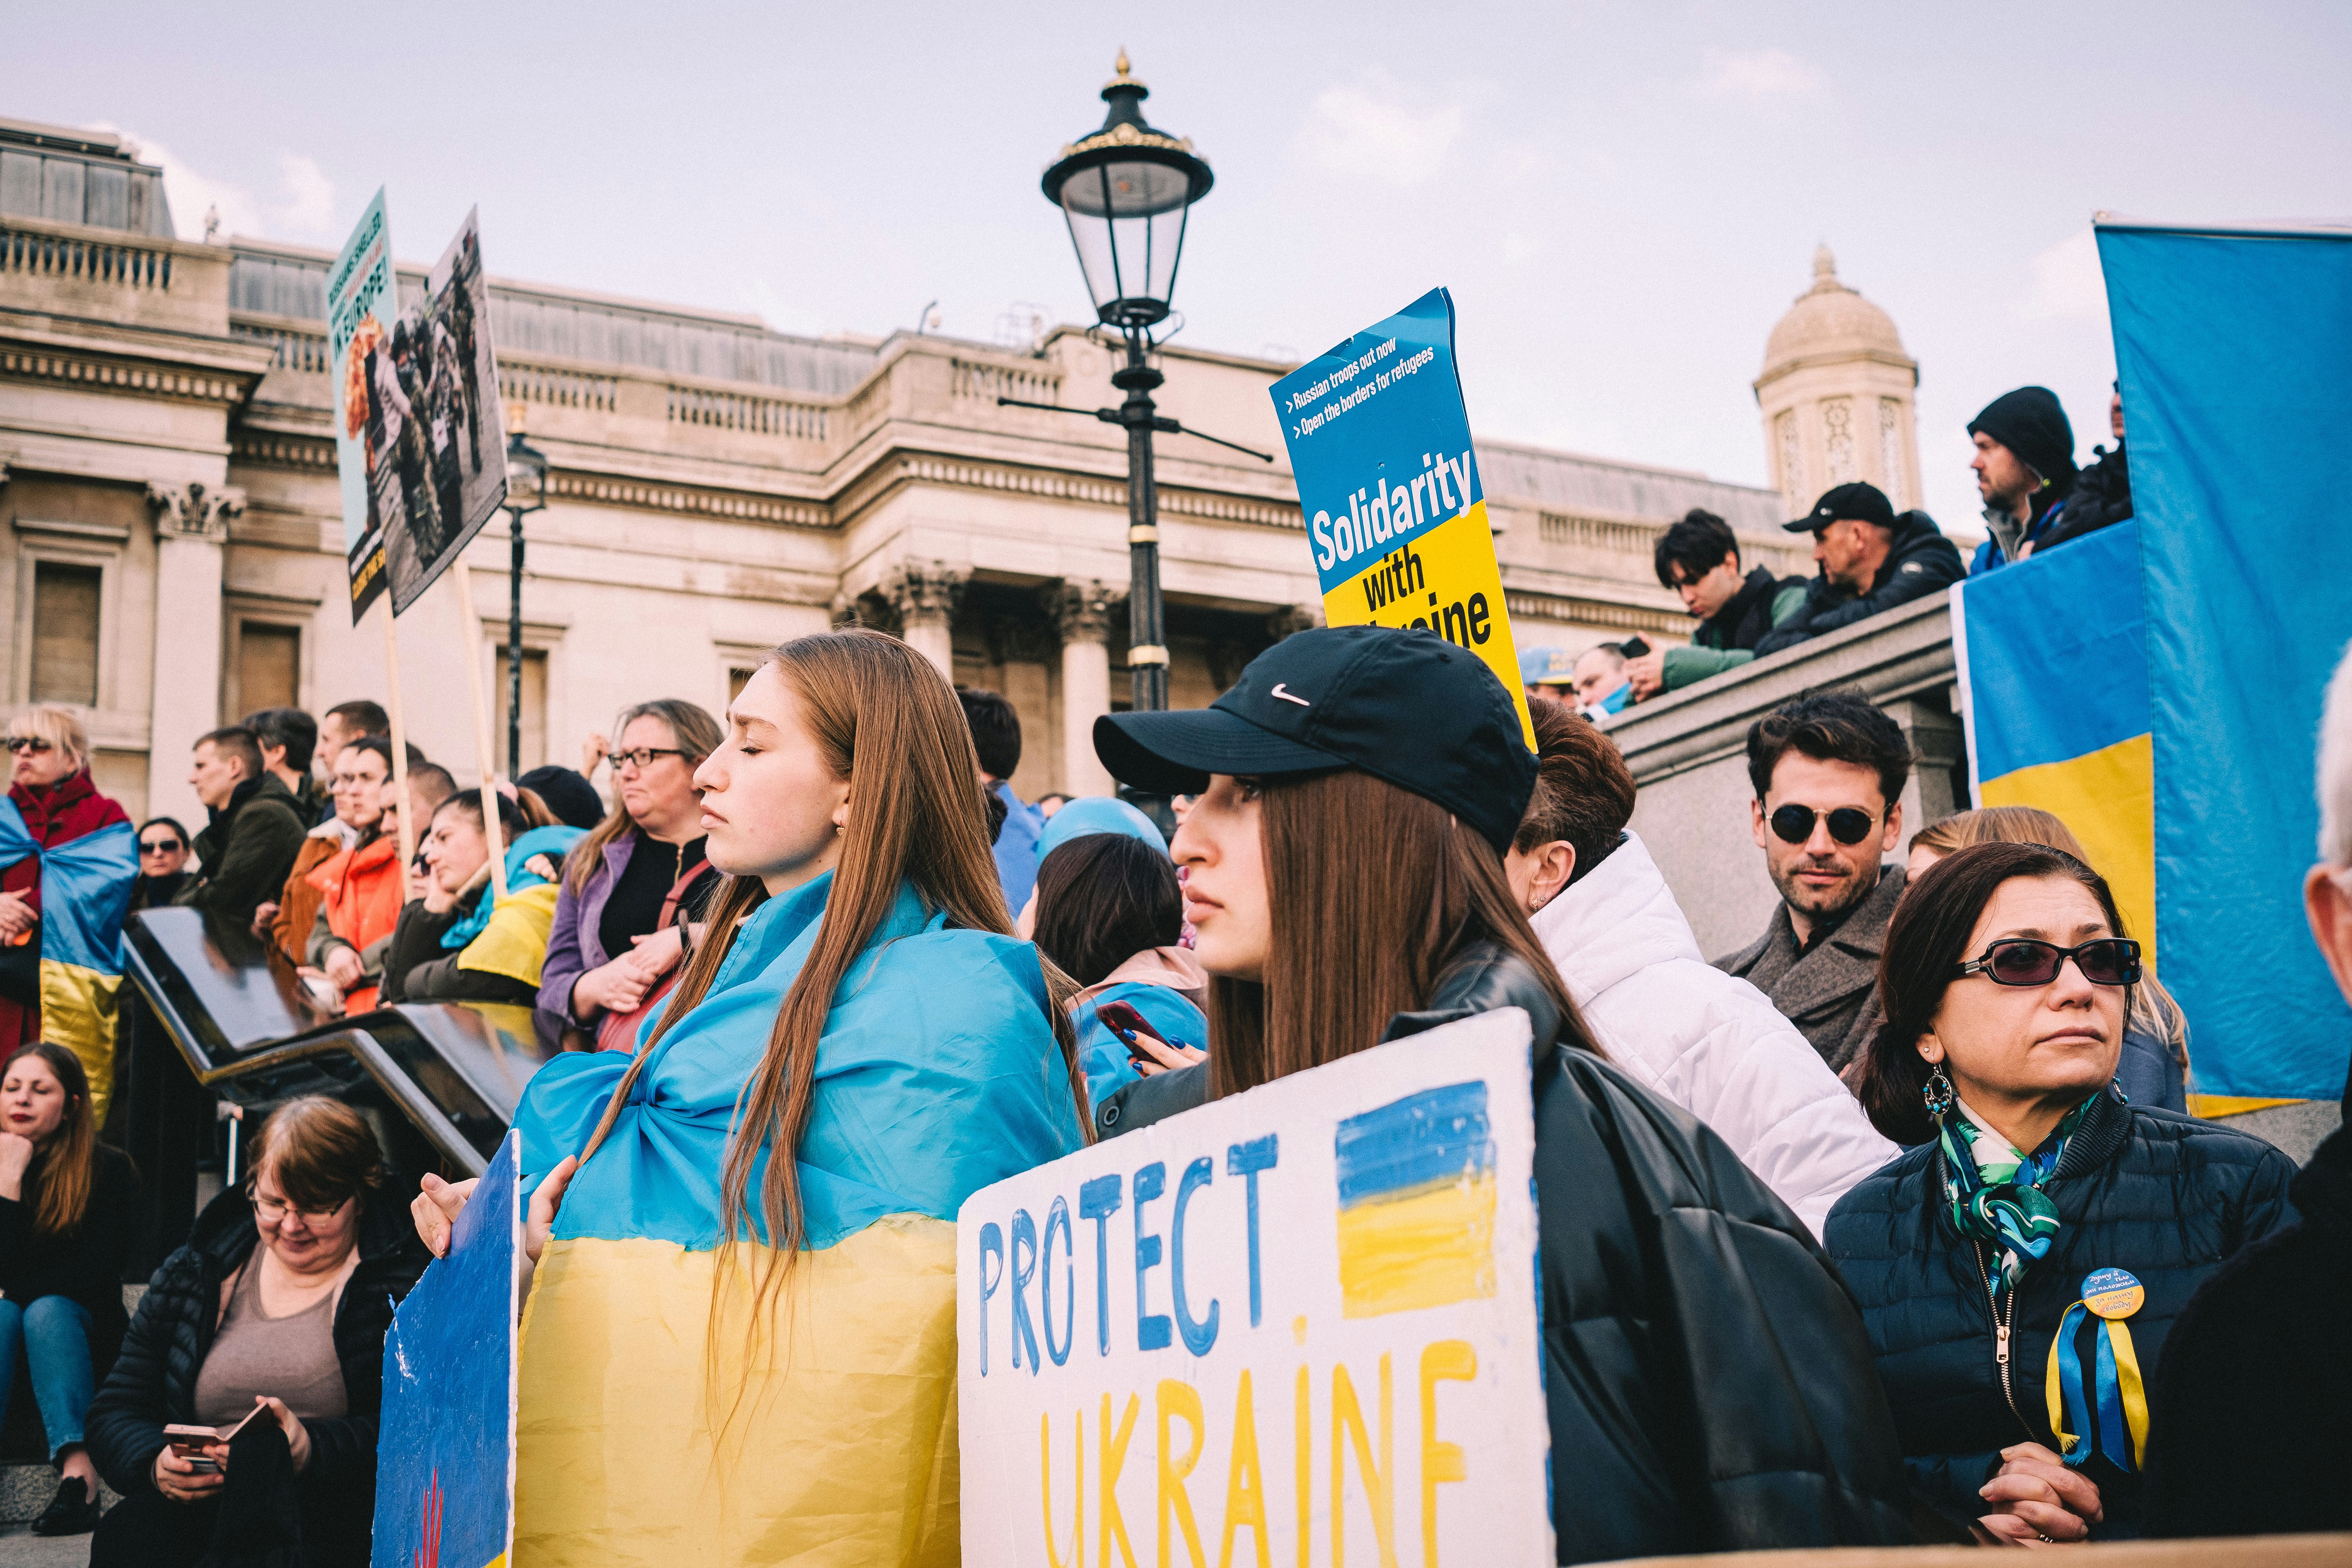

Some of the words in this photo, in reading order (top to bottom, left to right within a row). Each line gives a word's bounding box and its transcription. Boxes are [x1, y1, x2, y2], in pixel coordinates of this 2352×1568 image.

[1293, 379, 1330, 410] Russian
[1329, 361, 1359, 388] troops
[1359, 348, 1376, 370] out
[1376, 337, 1396, 360] now
[1301, 412, 1325, 436] Open
[1324, 403, 1341, 422] the
[1340, 381, 1376, 413] borders
[1376, 371, 1390, 391] for
[1390, 347, 1434, 383] refugees
[1313, 450, 1472, 571] Solidarity
[1363, 543, 1425, 612] with
[979, 1132, 1279, 1377] PROTECT
